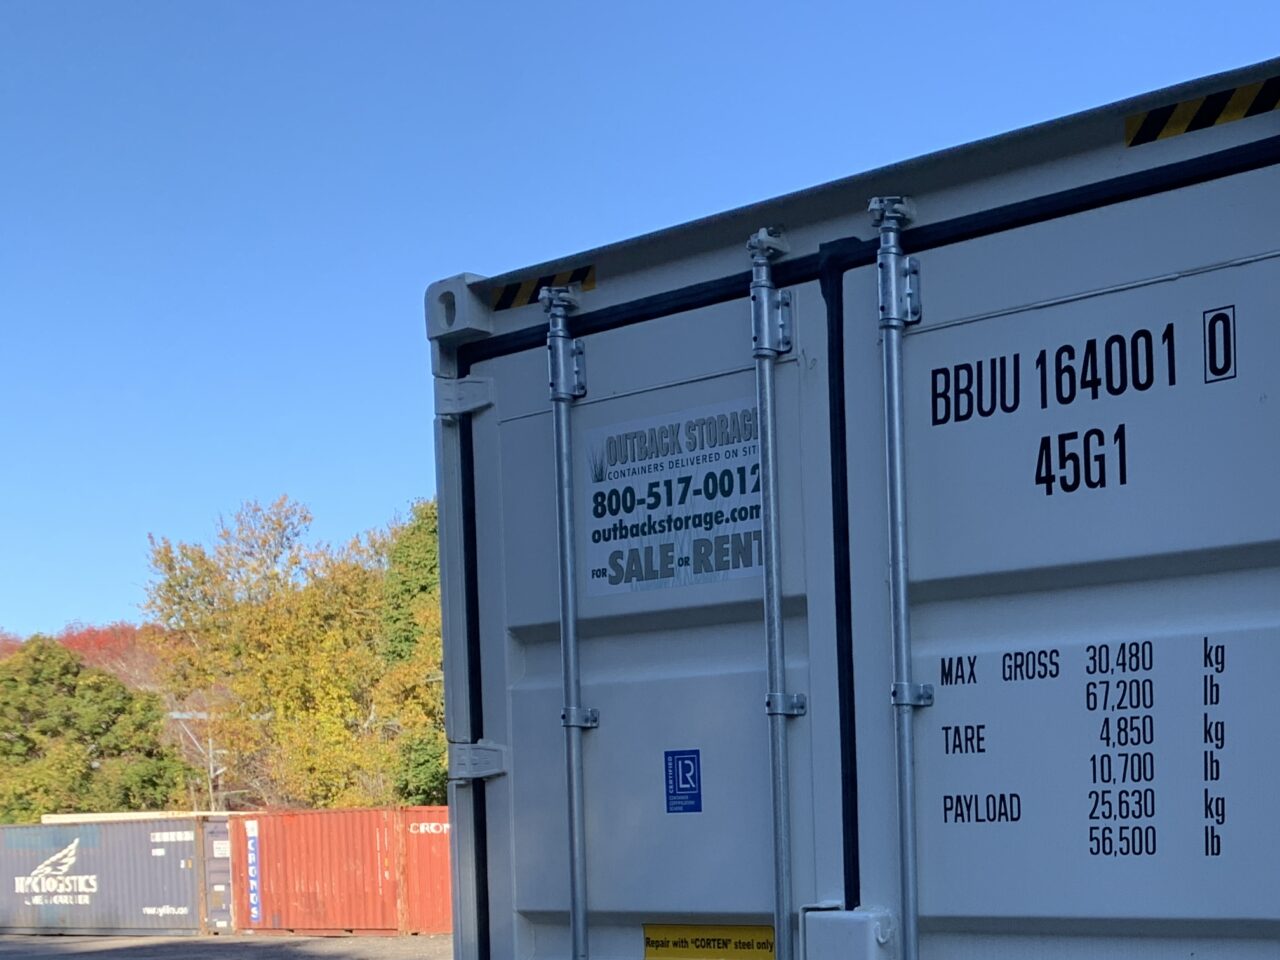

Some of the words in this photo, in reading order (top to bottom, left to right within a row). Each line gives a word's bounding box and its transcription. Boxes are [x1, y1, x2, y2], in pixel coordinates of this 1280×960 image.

[931, 353, 1020, 426] BBUU
[1036, 323, 1176, 409] 164001
[1207, 310, 1233, 379] 0
[606, 423, 683, 467] OUTBACK
[608, 463, 664, 481] CONTAINERS
[669, 452, 720, 470] DELIVERED
[725, 449, 738, 460] ON
[743, 445, 759, 456] SIT
[1035, 424, 1127, 496] 45G1
[592, 463, 761, 518] 800-517-0012
[591, 568, 607, 579] FOR
[608, 543, 674, 585] SALE
[678, 556, 690, 567] OR
[693, 530, 763, 574] RENT
[941, 656, 977, 685] MAX
[1002, 649, 1060, 681] GROSS
[1086, 641, 1153, 675] 30,480
[1204, 637, 1225, 673] kg
[1086, 679, 1153, 711] 67,200
[1204, 675, 1220, 706] lb
[942, 725, 986, 754] TARE
[1100, 715, 1154, 747] 4,850
[1204, 713, 1225, 749] kg
[1089, 752, 1154, 783] 10,700
[1204, 751, 1220, 781] lb
[943, 793, 1021, 823] PAYLOAD
[1088, 788, 1155, 821] 25,630
[1204, 788, 1225, 825] kg
[1089, 826, 1156, 856] 56,500
[1205, 826, 1221, 856] lb
[645, 937, 669, 950] Repair
[672, 939, 689, 948] with
[734, 939, 754, 950] steel
[757, 940, 773, 952] only
